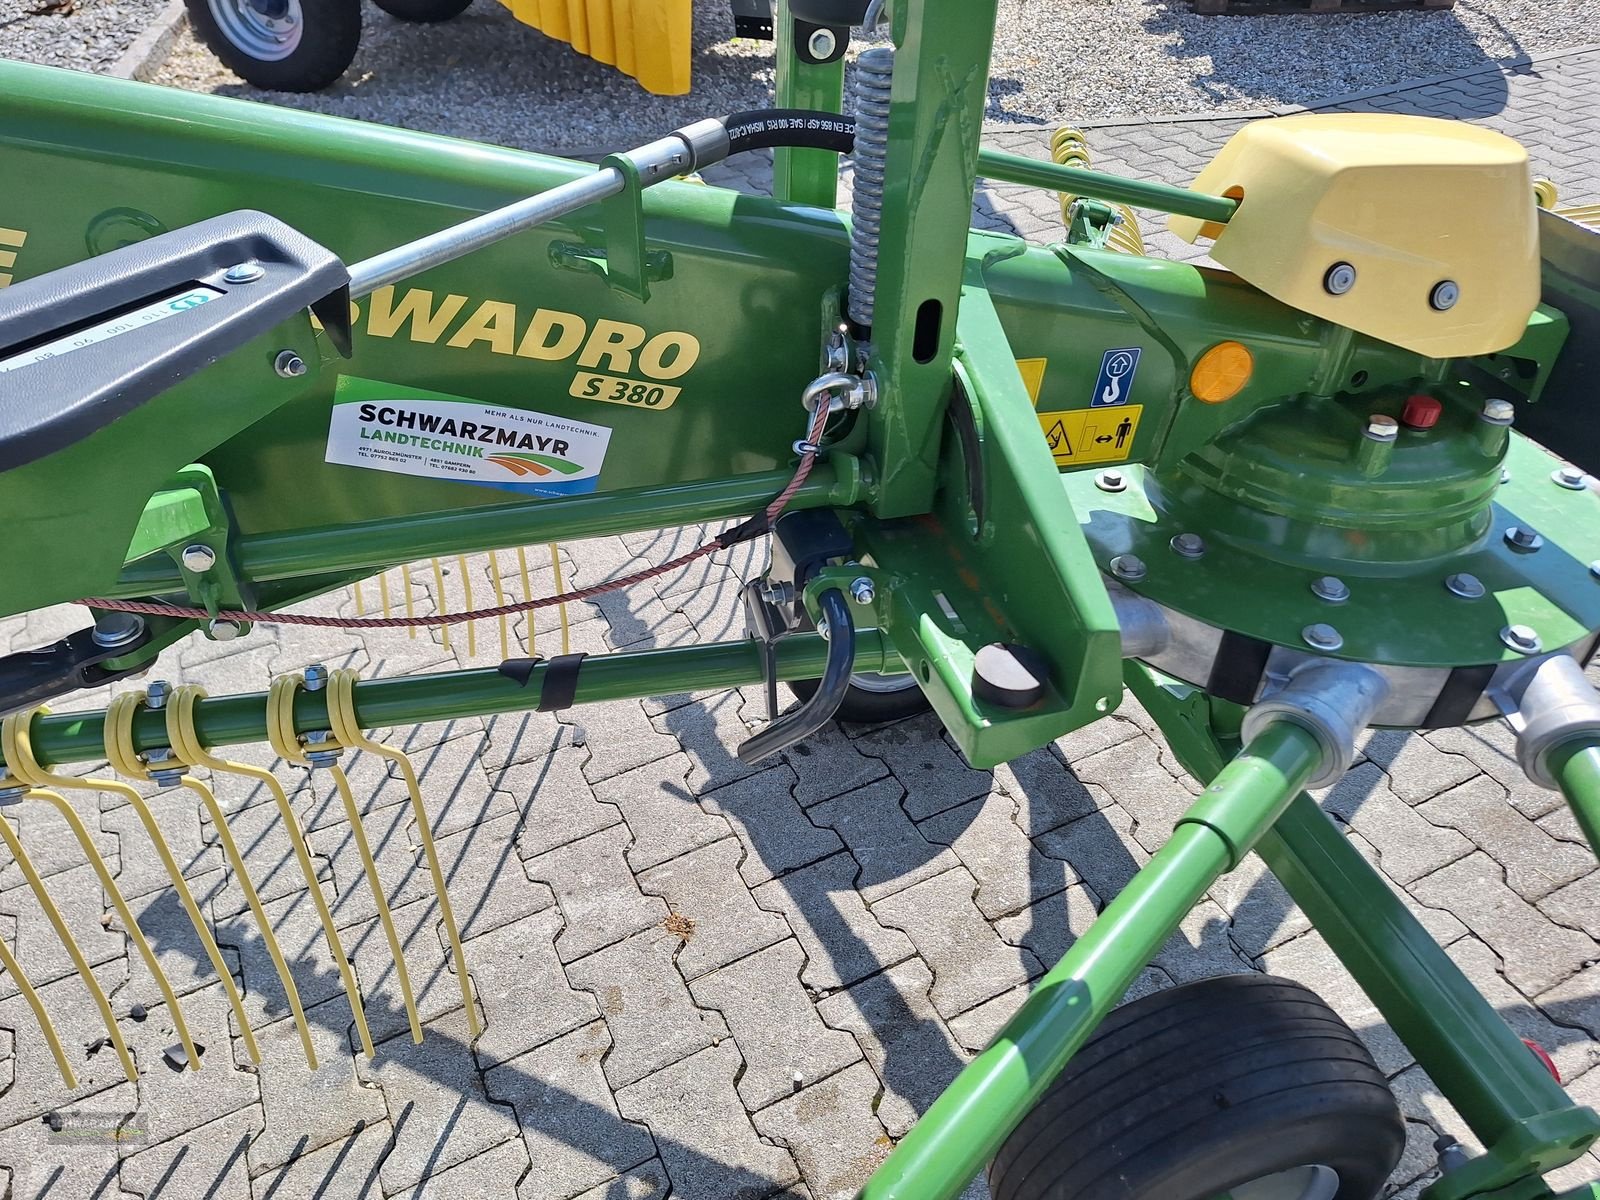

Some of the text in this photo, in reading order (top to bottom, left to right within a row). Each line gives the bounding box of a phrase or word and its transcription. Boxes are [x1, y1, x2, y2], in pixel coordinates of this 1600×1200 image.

[766, 119, 778, 131] R15
[778, 119, 789, 129] 100
[789, 118, 804, 129] SAE
[833, 122, 844, 133] EN
[311, 284, 701, 380] WADRO
[582, 377, 665, 407] S 380
[358, 403, 570, 457] SCHWARZMAYR
[484, 409, 600, 438] MEHR ALS NUR LANDTECHNIK.
[360, 427, 485, 458] LANDTECHNIK
